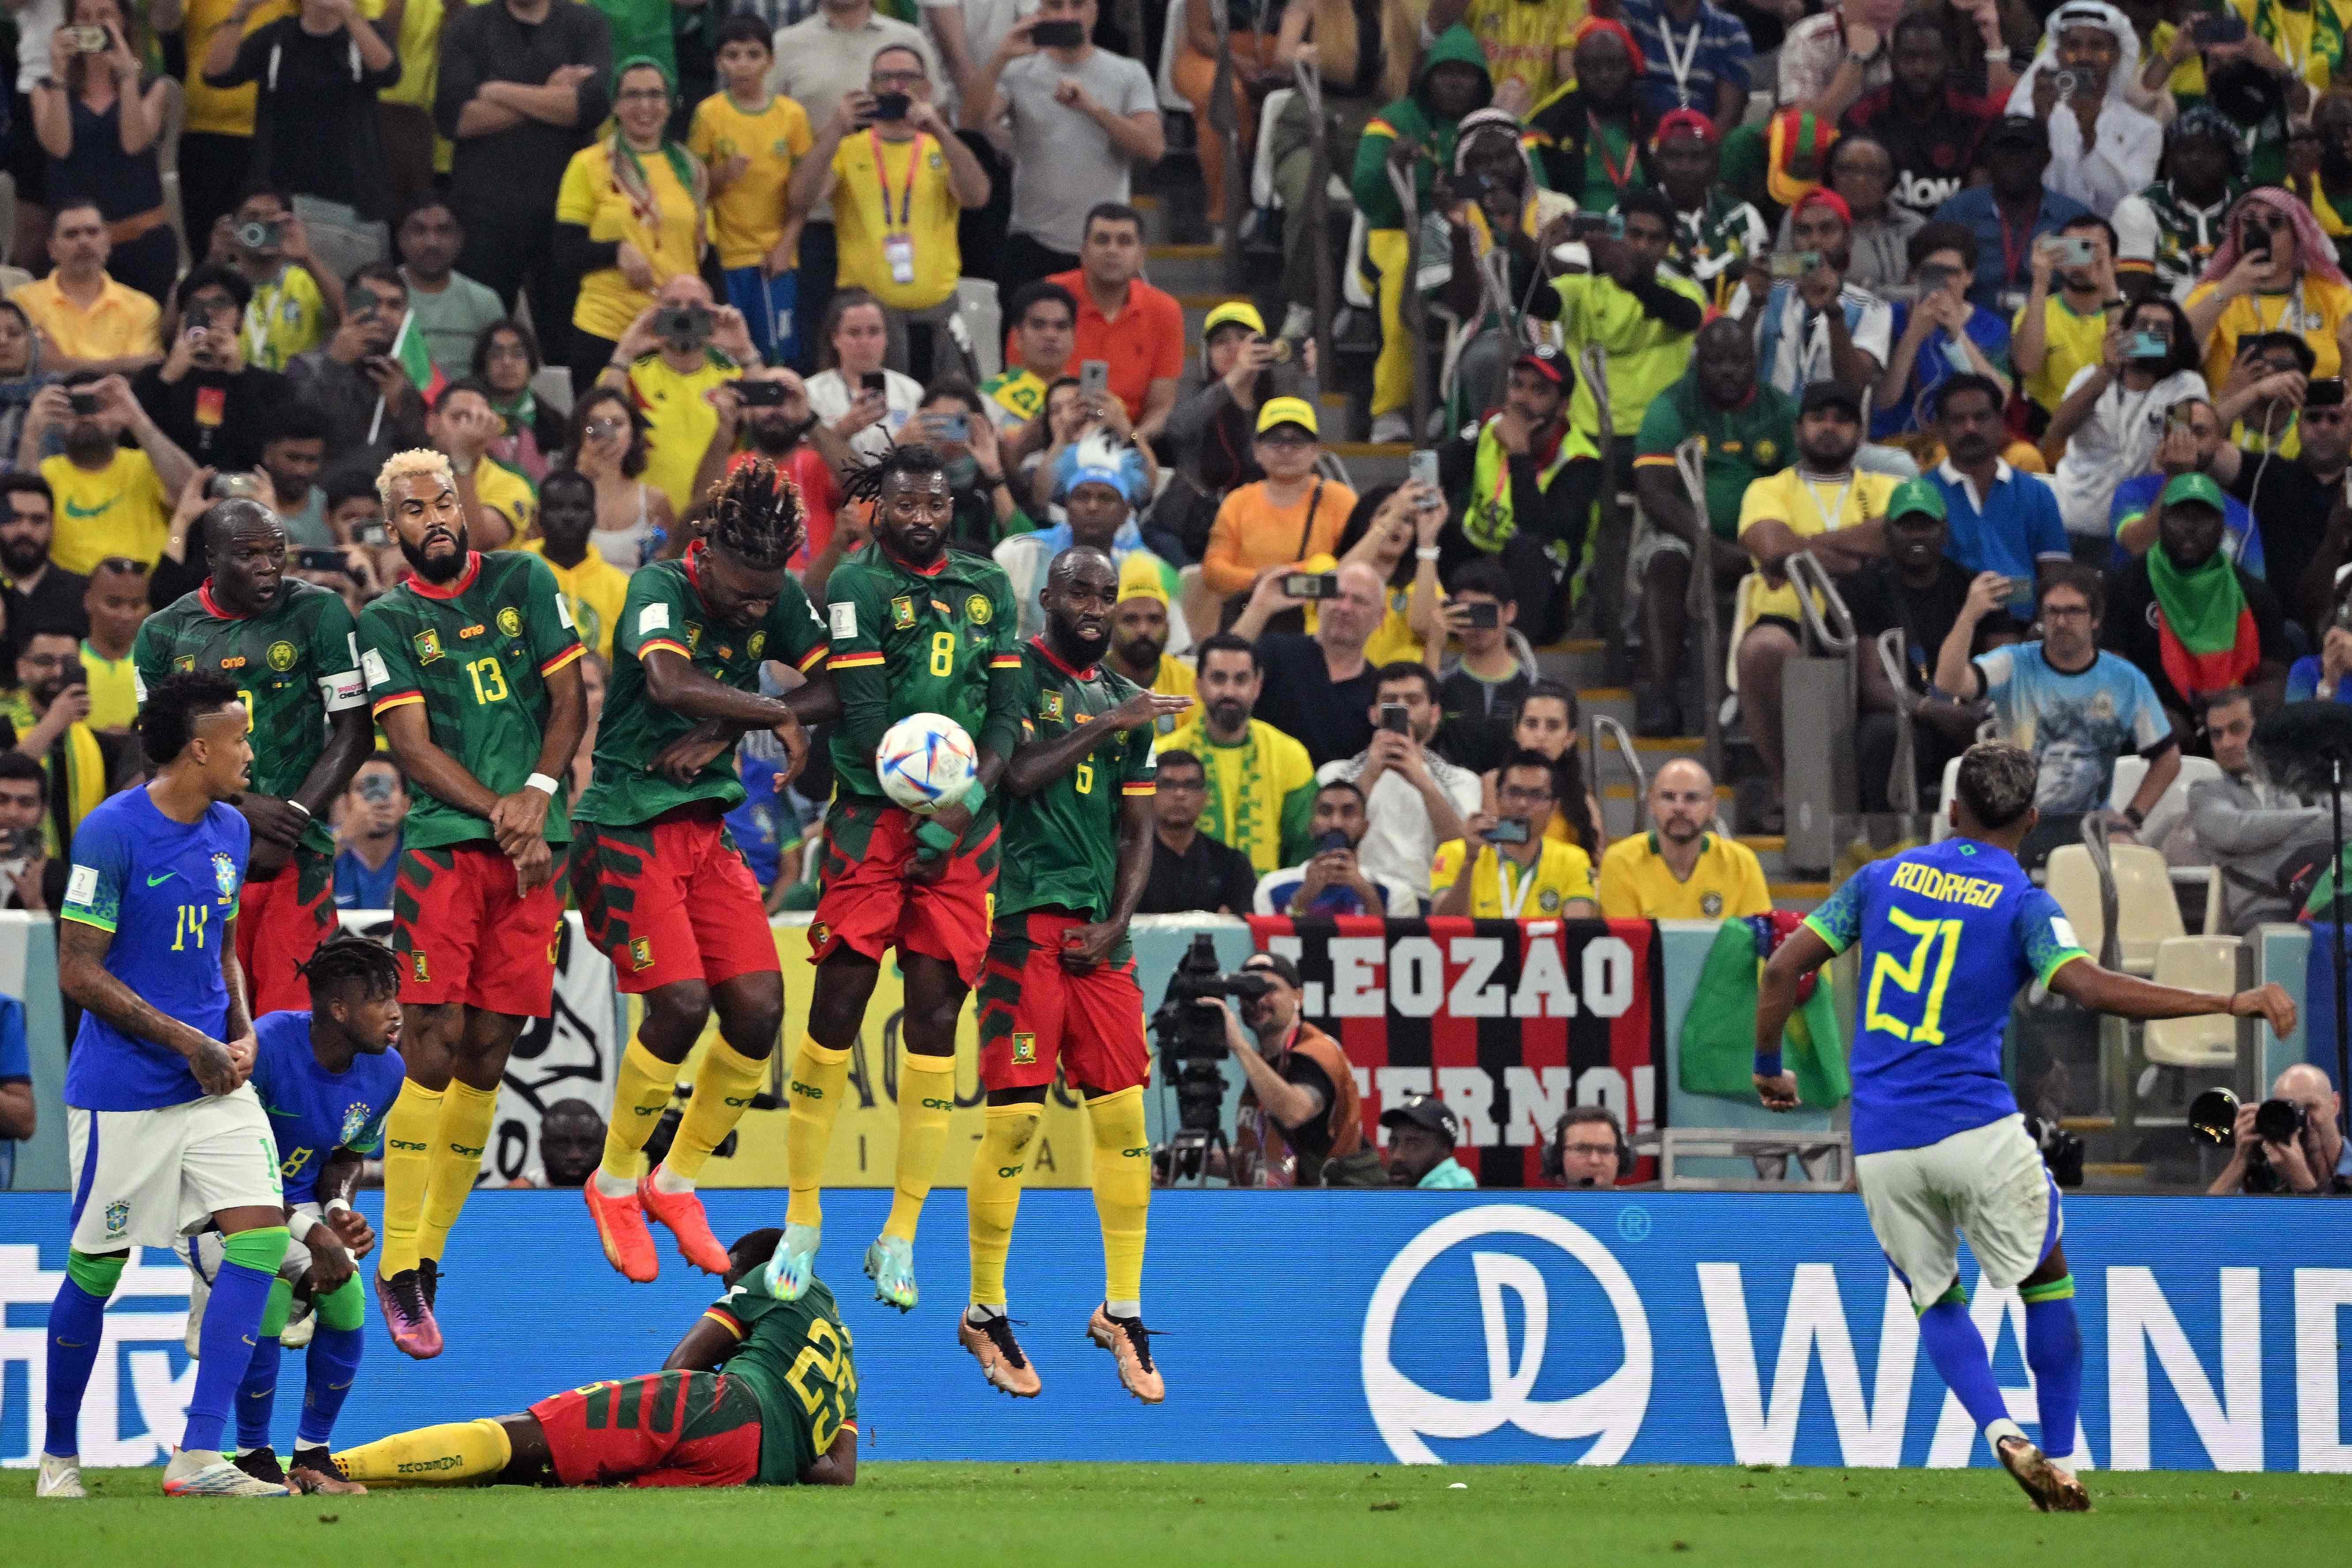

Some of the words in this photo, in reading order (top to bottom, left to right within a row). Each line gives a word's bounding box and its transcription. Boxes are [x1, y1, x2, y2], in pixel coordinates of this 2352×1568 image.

[459, 624, 485, 639] one
[221, 655, 246, 670] one
[930, 632, 955, 677] 8
[466, 657, 508, 704] 13
[1890, 862, 2003, 909] RODRYGO
[171, 905, 208, 951] 14
[1865, 905, 1964, 1046] 21
[791, 1080, 823, 1099] one
[281, 1146, 314, 1178] 8
[389, 1139, 427, 1151] one
[784, 1318, 857, 1456] 25
